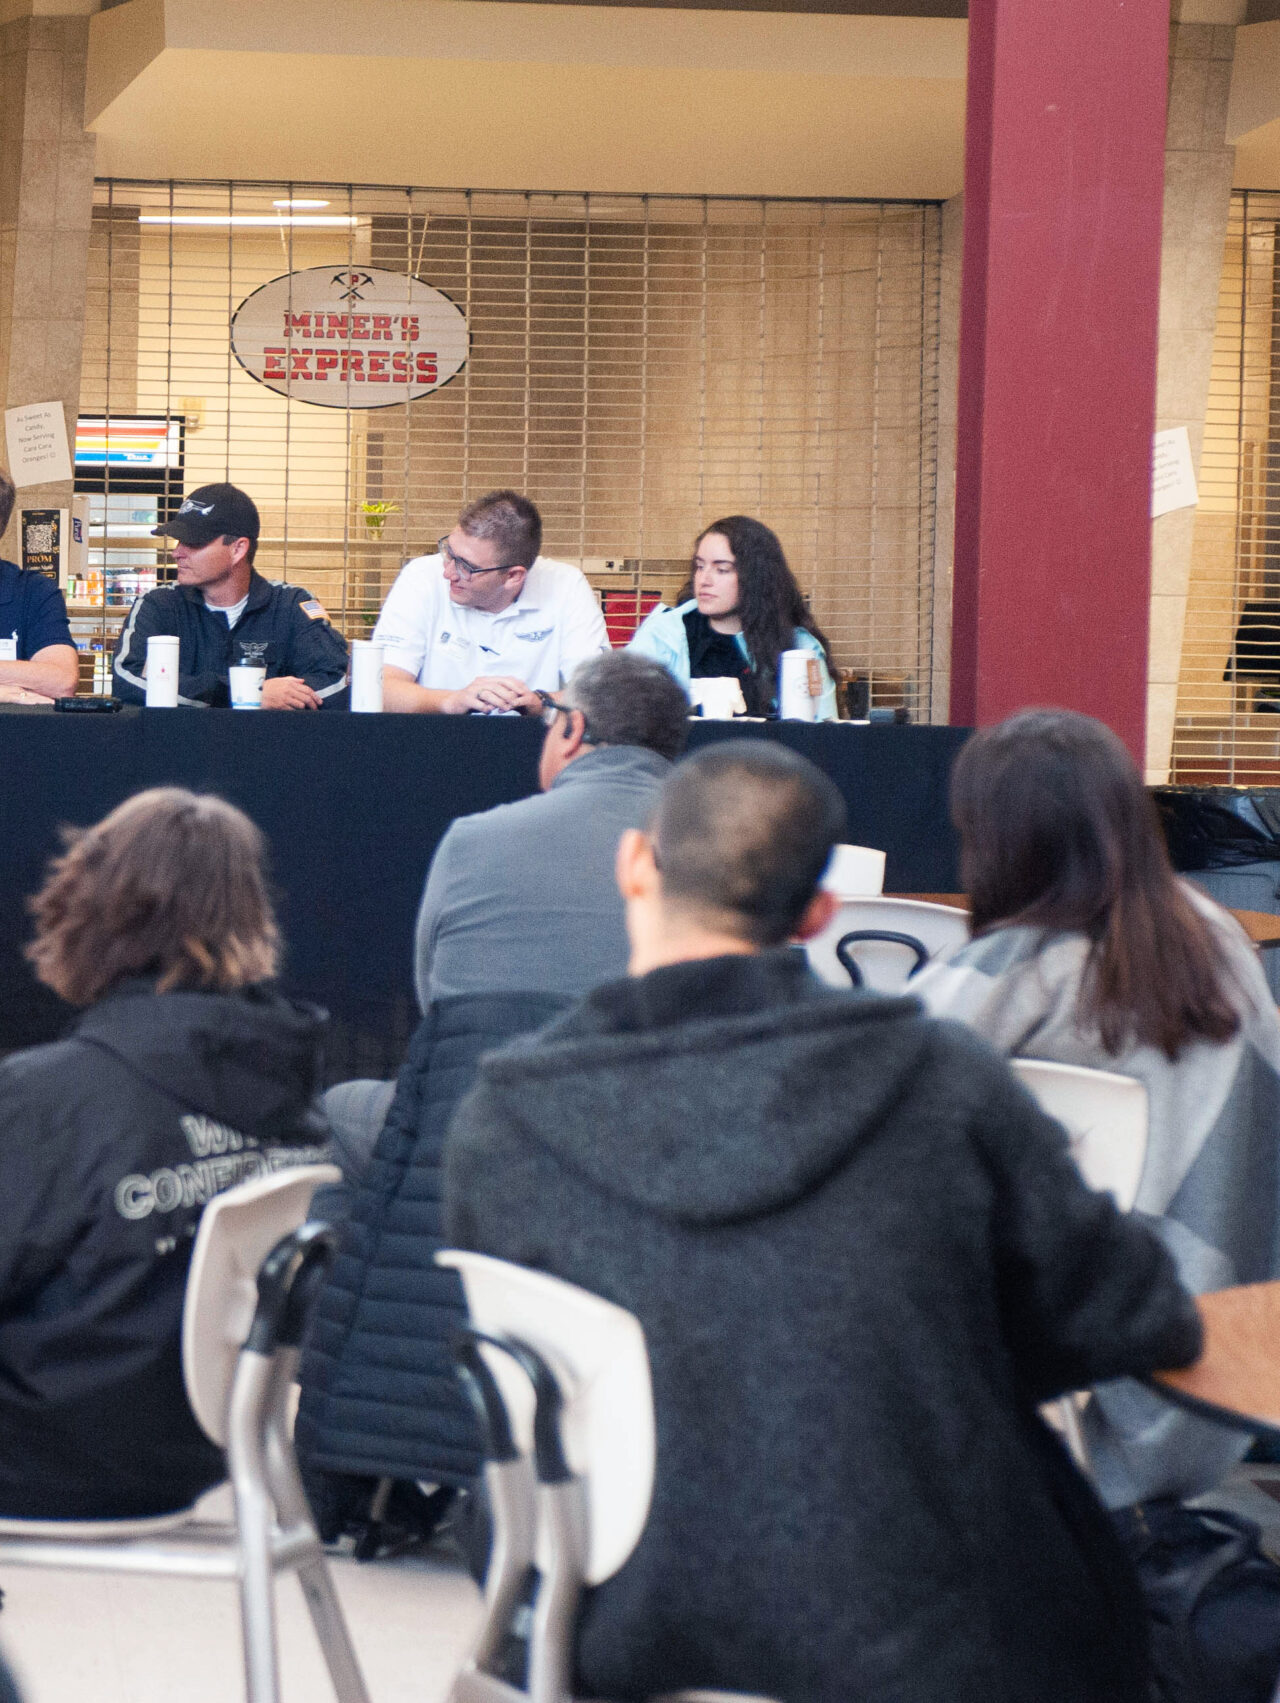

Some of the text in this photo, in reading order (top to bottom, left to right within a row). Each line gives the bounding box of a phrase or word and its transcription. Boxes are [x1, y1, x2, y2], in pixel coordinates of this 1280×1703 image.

[283, 310, 420, 341] MINER'S
[263, 347, 438, 384] EXPRESS
[24, 412, 42, 421] Sweet
[33, 432, 55, 440] Serving
[26, 554, 53, 563] PROM
